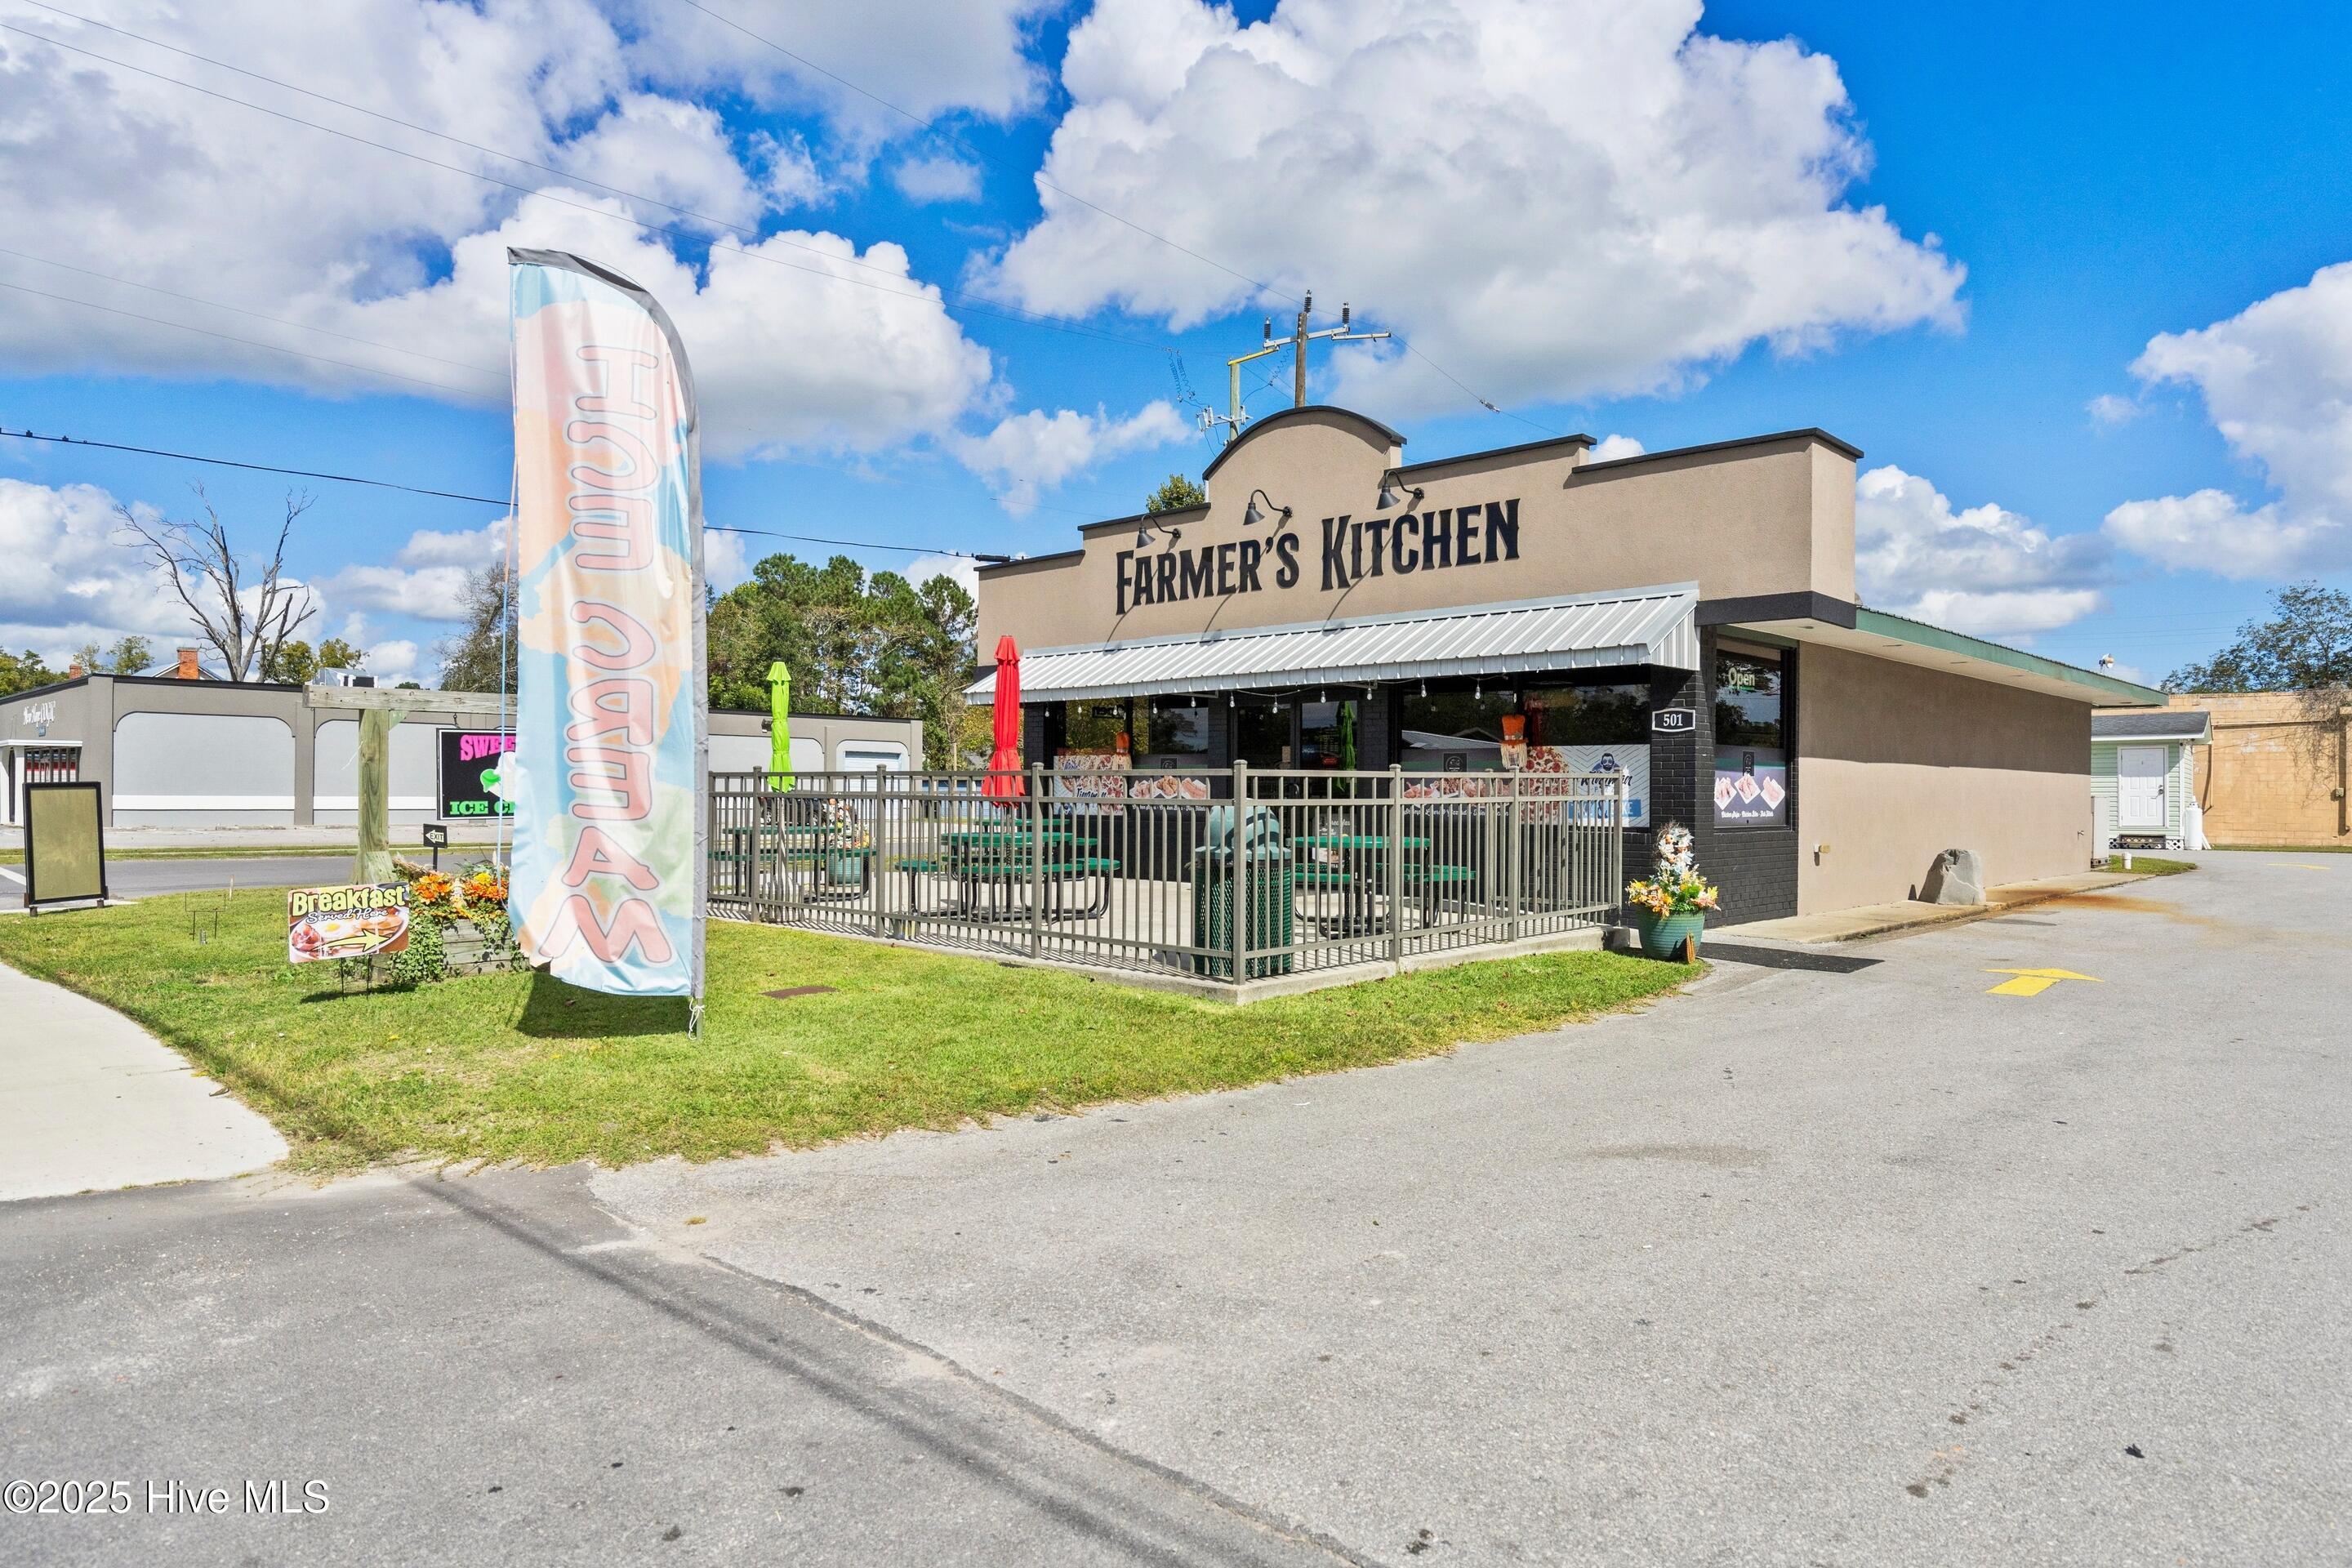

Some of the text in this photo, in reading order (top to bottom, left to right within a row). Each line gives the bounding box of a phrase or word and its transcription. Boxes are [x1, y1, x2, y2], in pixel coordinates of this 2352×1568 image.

[1116, 498, 1521, 615] FARMER'S KITCHEN
[1728, 667, 1756, 689] Open
[1663, 713, 1684, 727] 501
[460, 734, 516, 761] SWEE
[450, 800, 489, 815] ICE
[292, 885, 406, 916] Breakfast
[305, 907, 388, 923] Served Here
